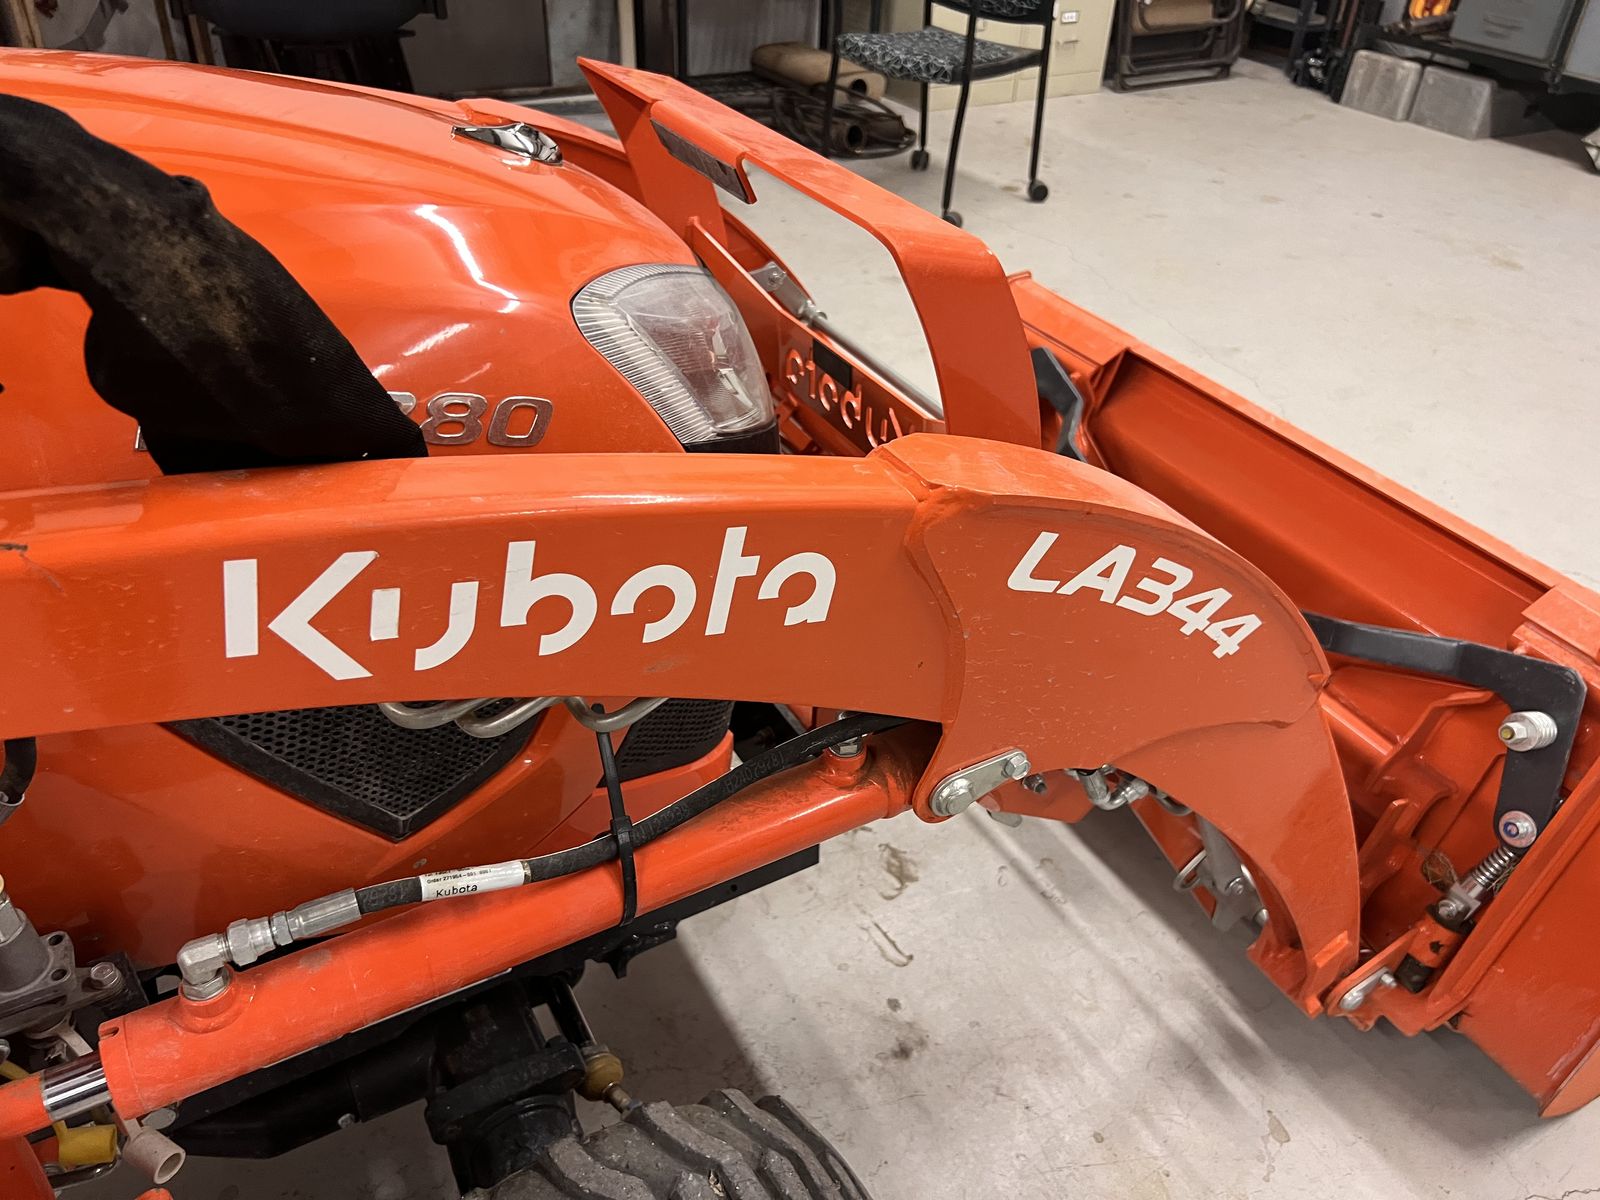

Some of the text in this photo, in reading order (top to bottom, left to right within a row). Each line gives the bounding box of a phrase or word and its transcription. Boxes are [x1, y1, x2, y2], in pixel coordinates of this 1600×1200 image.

[223, 526, 837, 680] Kubota
[1007, 531, 1262, 659] LA344
[436, 883, 478, 898] Kubota
